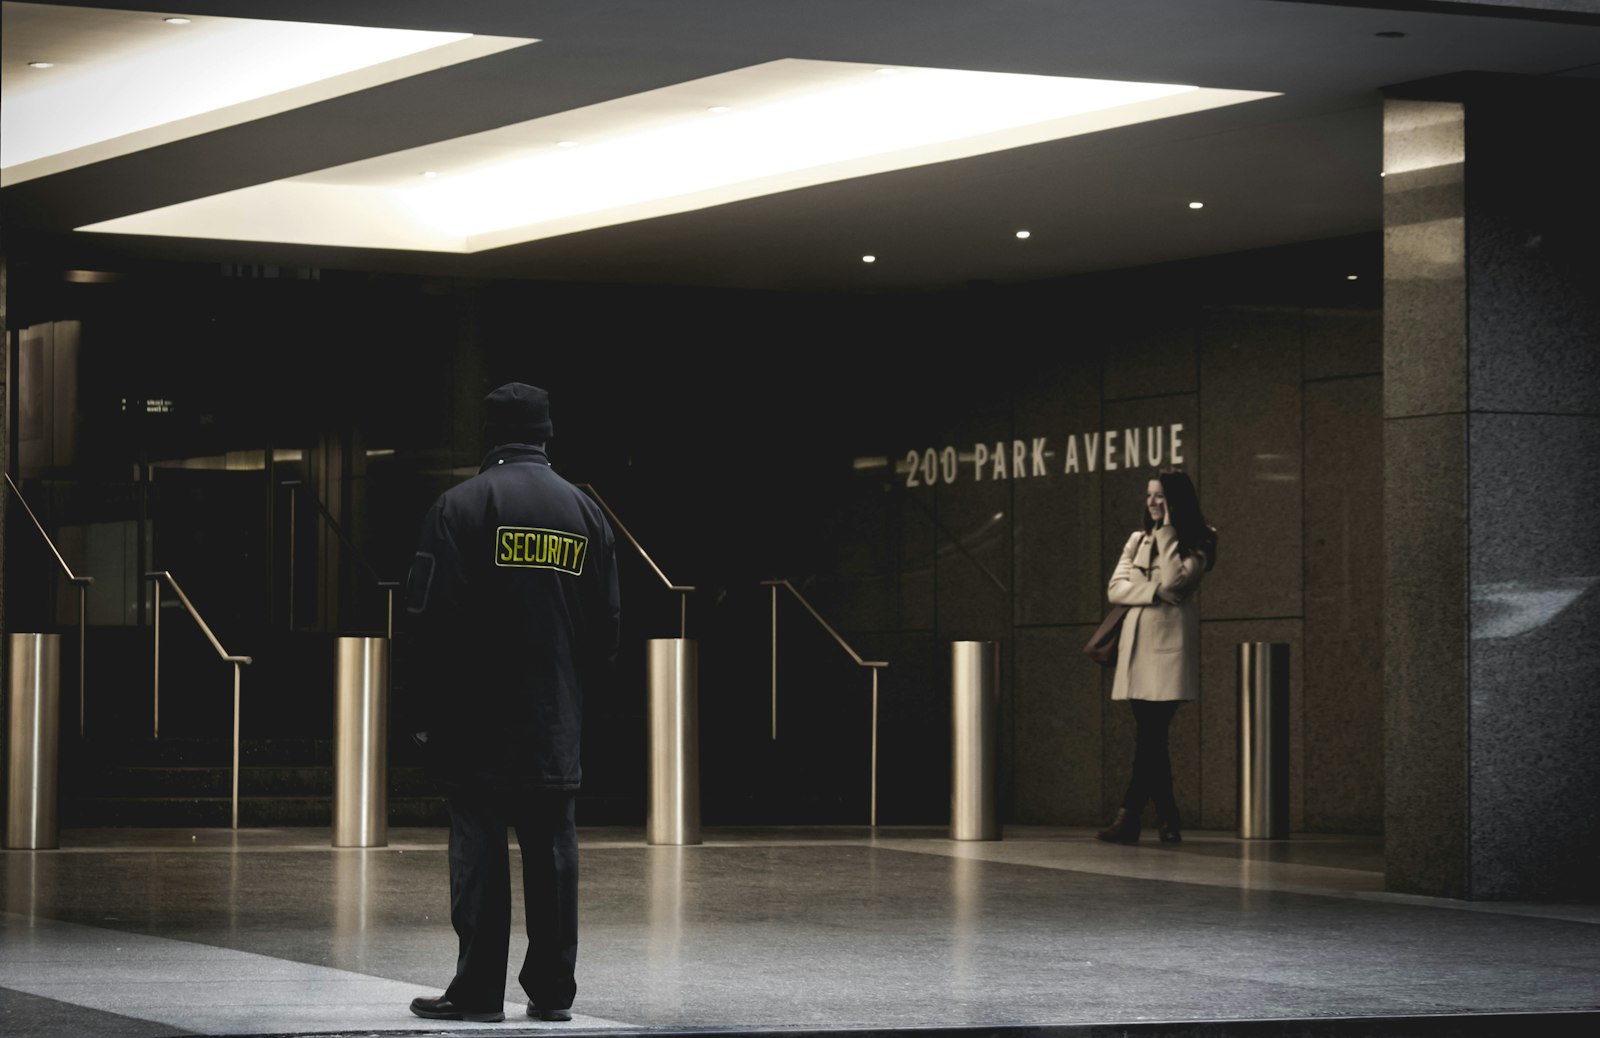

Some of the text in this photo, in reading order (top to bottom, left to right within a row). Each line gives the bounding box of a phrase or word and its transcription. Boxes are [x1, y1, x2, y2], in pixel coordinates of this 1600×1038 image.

[906, 423, 1184, 487] 200 PARK AVENUE
[501, 532, 584, 569] SECURITY
